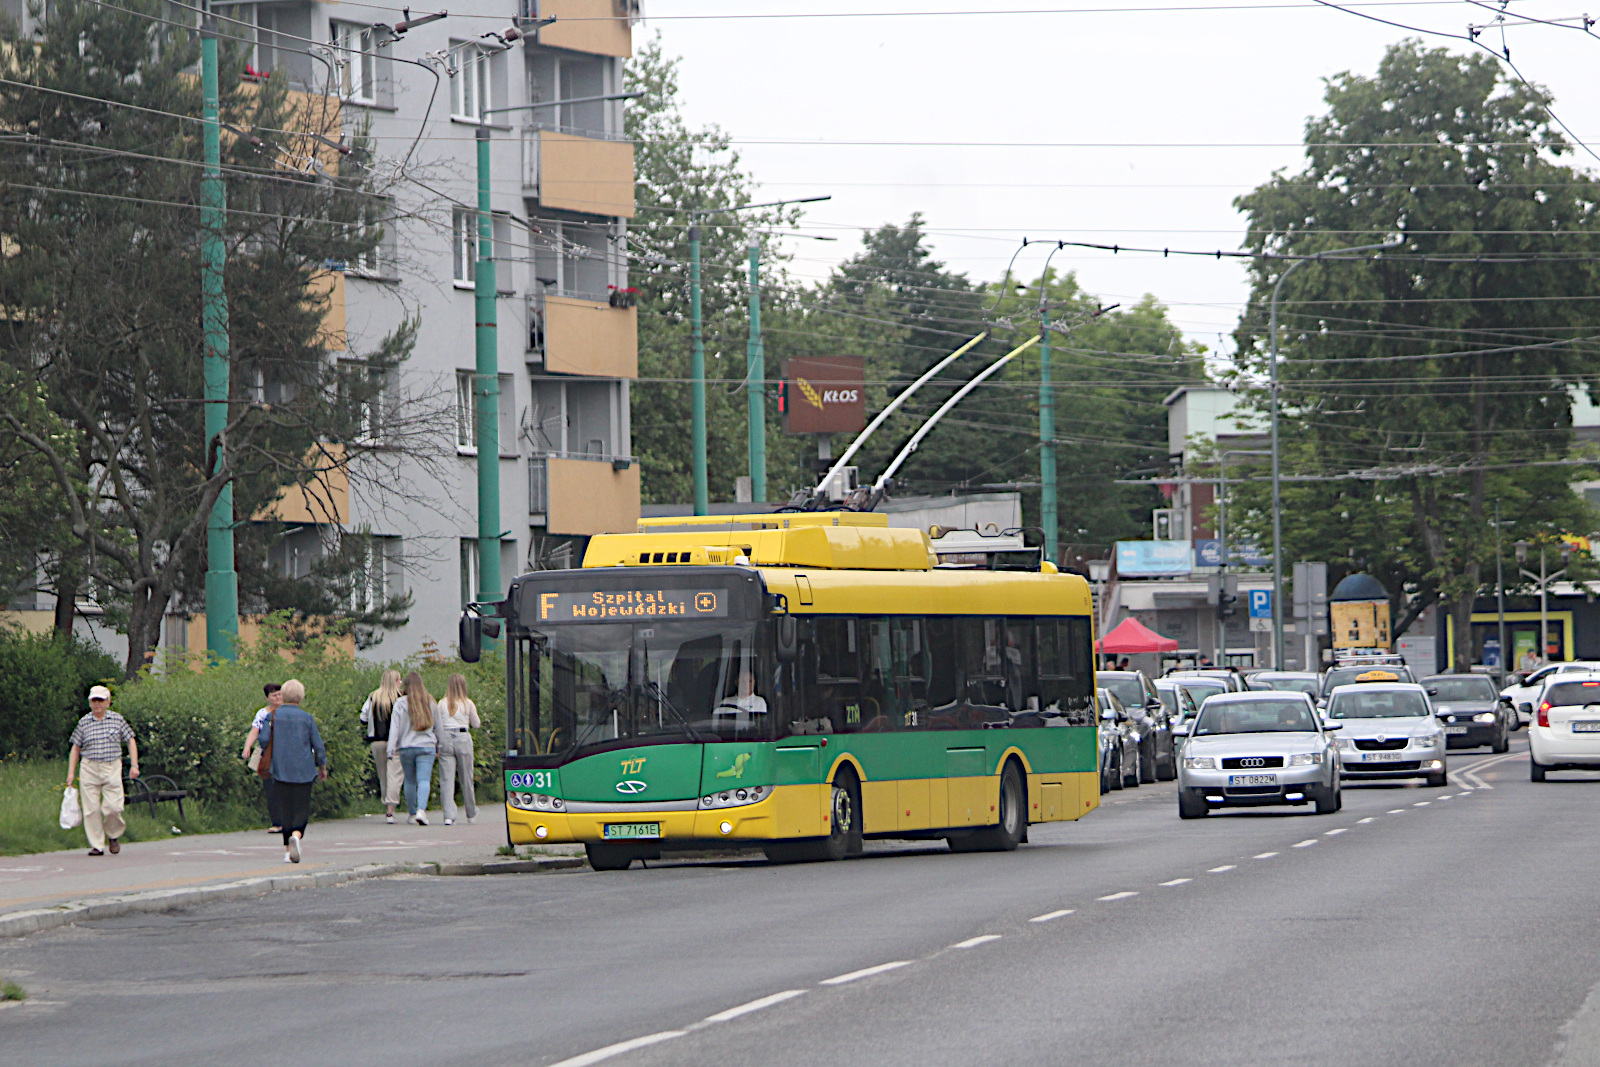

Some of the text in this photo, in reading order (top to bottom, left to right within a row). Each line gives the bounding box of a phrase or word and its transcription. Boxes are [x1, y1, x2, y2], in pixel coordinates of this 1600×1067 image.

[823, 390, 858, 403] KŁOS
[541, 593, 559, 619] F
[592, 591, 665, 605] Szpital
[1253, 591, 1267, 610] P
[572, 602, 685, 618] Wojewódzki
[846, 704, 861, 723] ZTM
[1366, 753, 1377, 761] ST
[620, 756, 647, 775] TLT
[535, 772, 552, 788] 31
[1234, 775, 1275, 784] ST 0822M
[610, 824, 657, 836] ST 7161E
